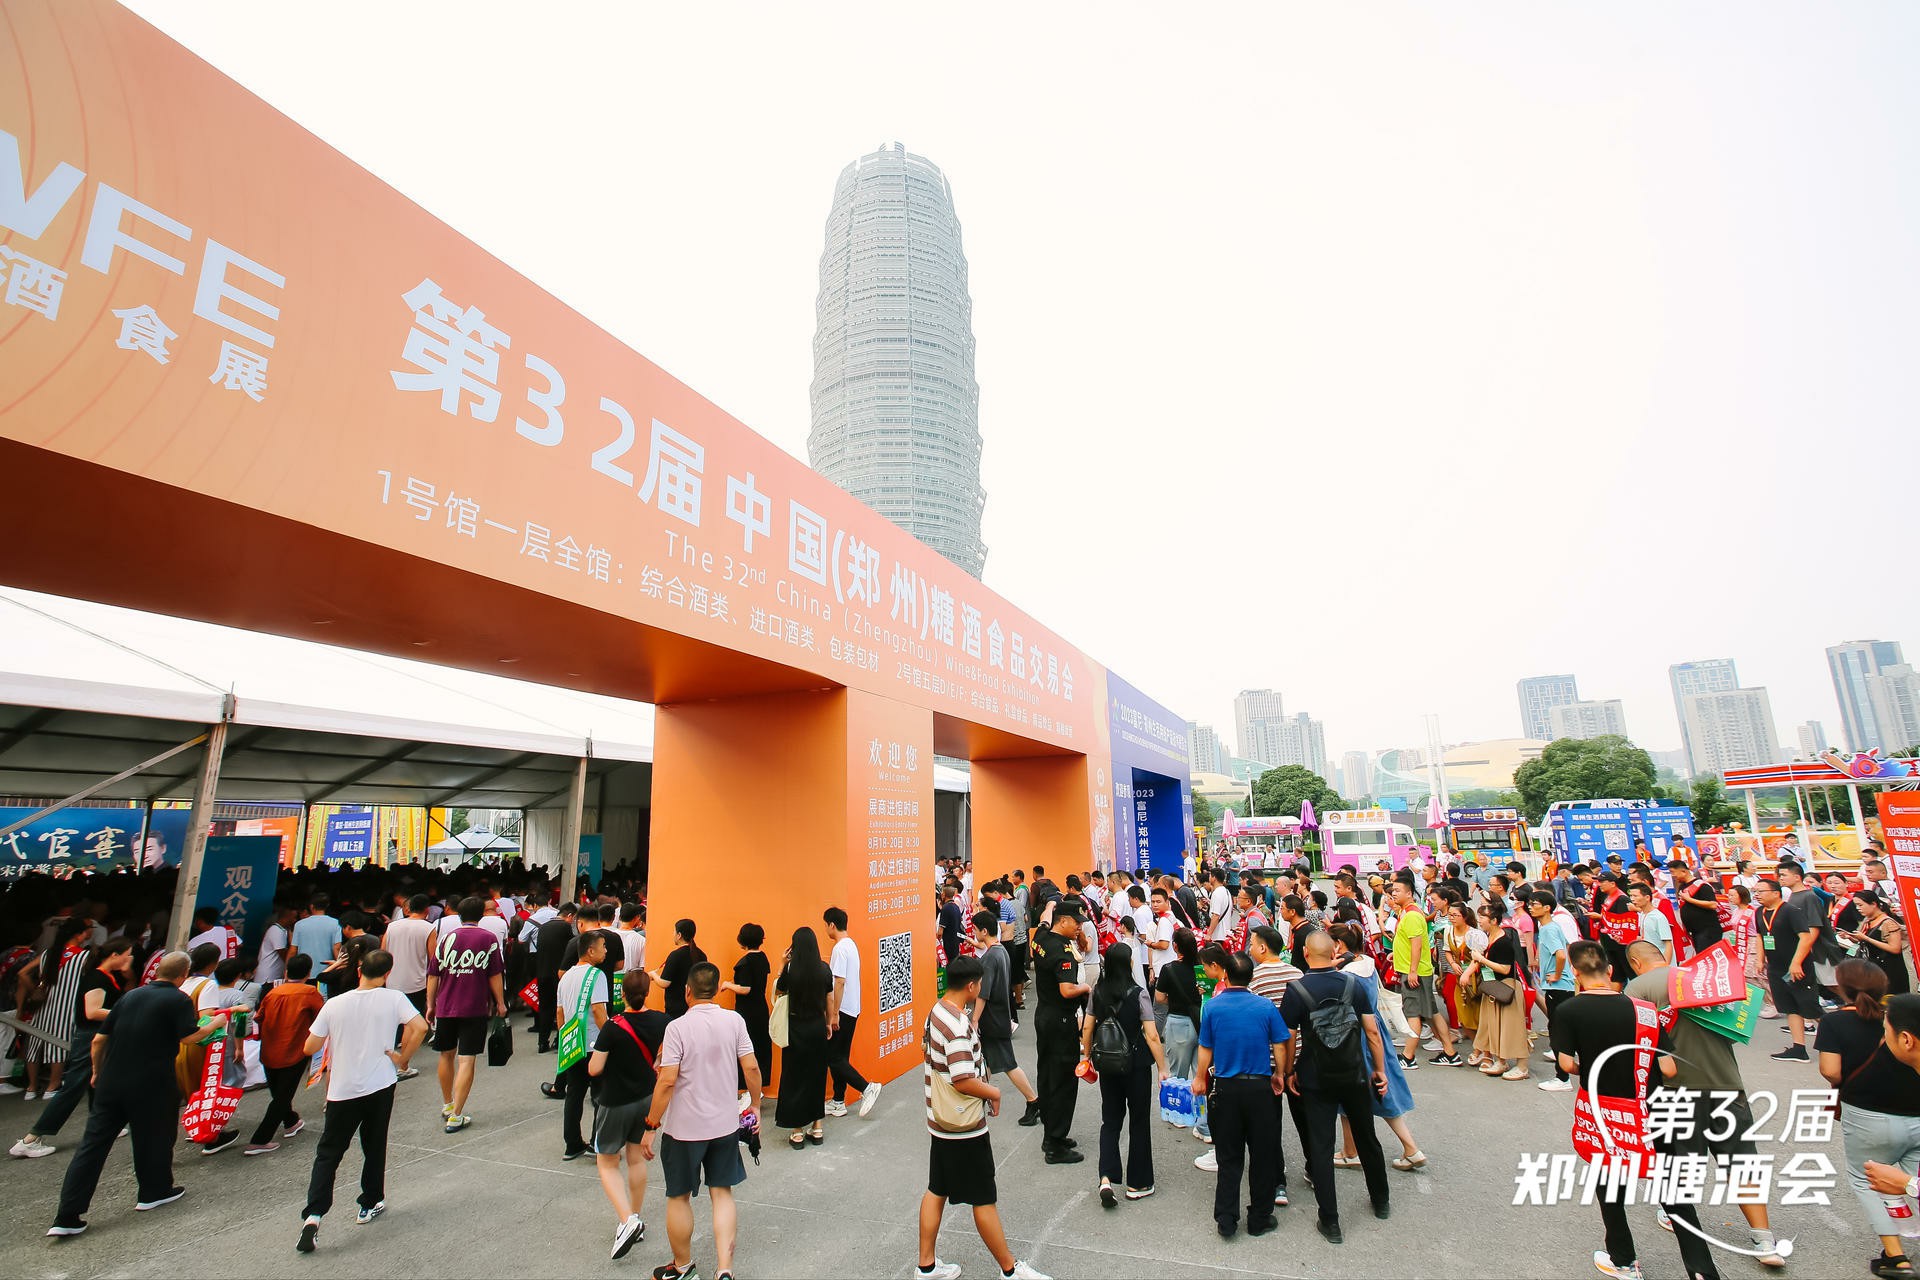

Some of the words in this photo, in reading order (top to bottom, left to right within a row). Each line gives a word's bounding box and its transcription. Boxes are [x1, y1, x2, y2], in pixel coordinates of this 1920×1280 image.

[664, 529, 713, 573] The
[723, 555, 766, 588] 32nd
[776, 580, 831, 622] China
[844, 608, 938, 668] (Zhengzhou)
[868, 738, 918, 772] 欢迎您
[879, 771, 911, 783] Welcome
[201, 1041, 223, 1121] 中国食品代理网
[213, 1109, 233, 1121] SPD
